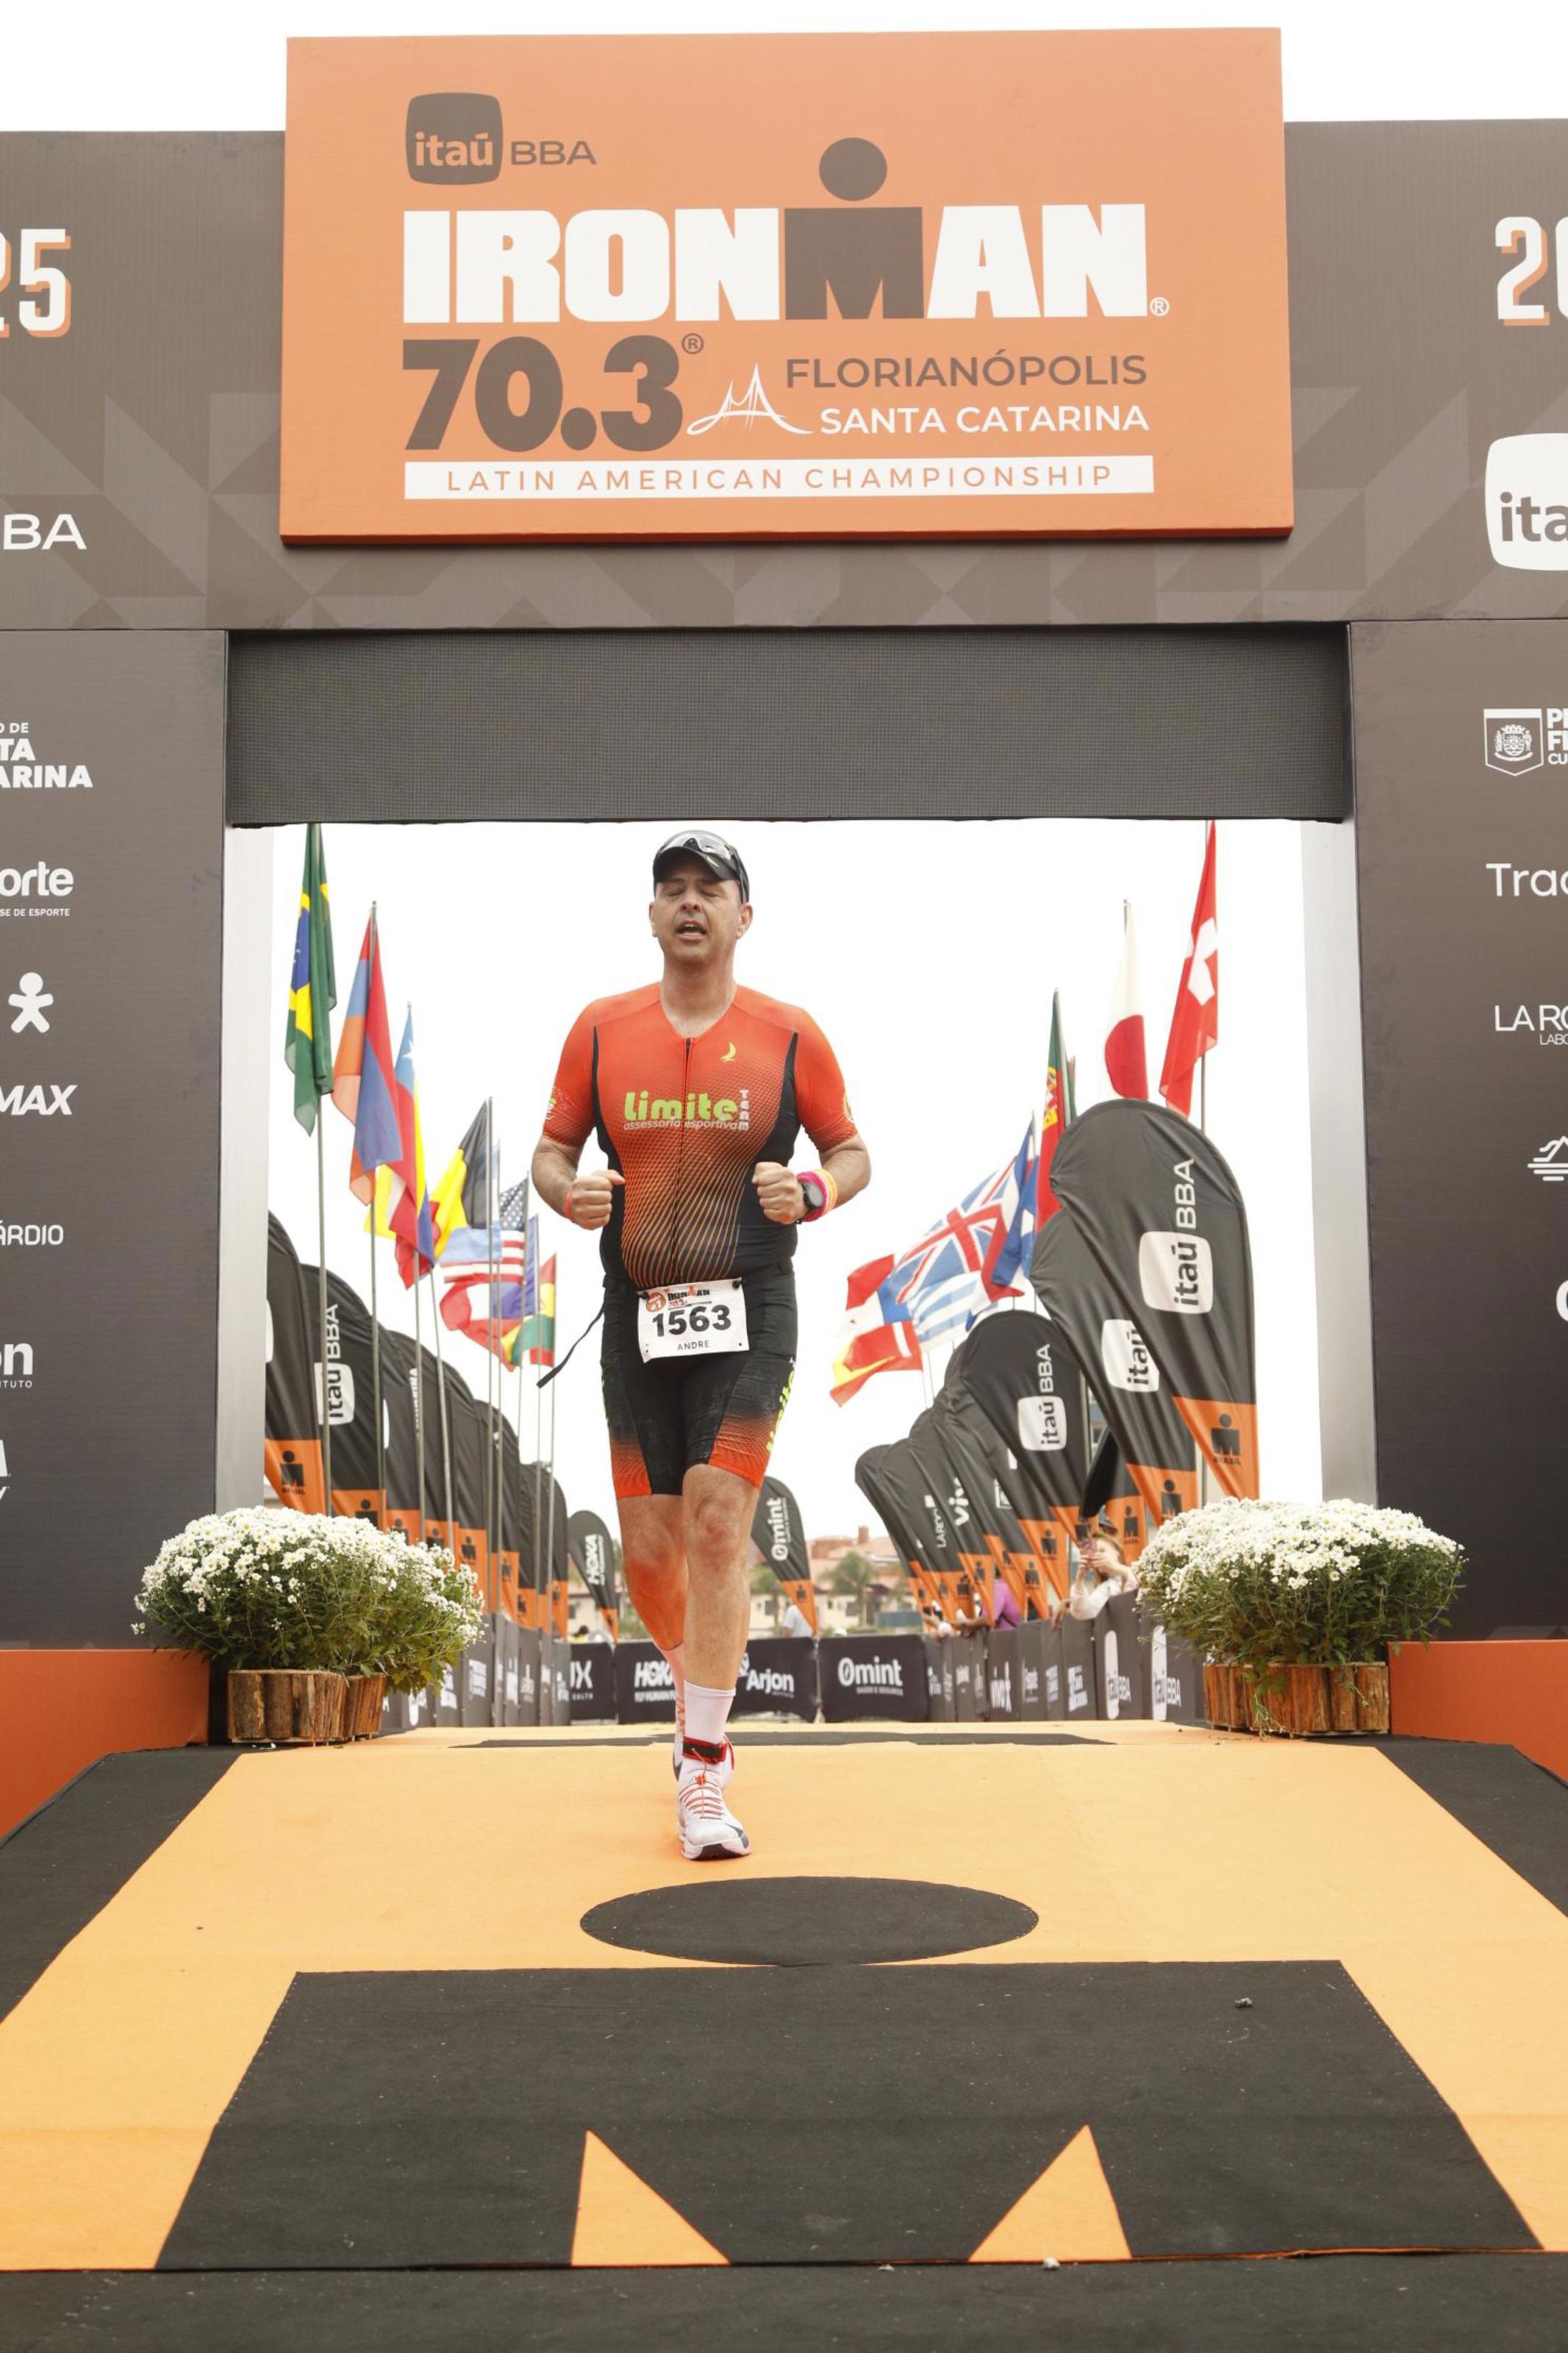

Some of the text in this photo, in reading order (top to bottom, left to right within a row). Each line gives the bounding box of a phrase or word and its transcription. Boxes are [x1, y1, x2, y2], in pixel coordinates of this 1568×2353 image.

[415, 131, 597, 166] itaú BBA
[0, 228, 71, 338] 5
[1495, 216, 1568, 326] 2
[786, 349, 1148, 389] FLORIANÓPOLIS
[820, 404, 1150, 434] SANTA CATARINA
[448, 465, 1111, 491] LATIN AMERICAN CHAMPIONSHIP
[10, 723, 29, 733] DE
[14, 908, 26, 916] DE
[29, 908, 71, 917] ESPORTE
[623, 1116, 681, 1131] assessoria
[1170, 1158, 1200, 1306] itaú BBA
[652, 1304, 731, 1338] 1563
[677, 1340, 710, 1352] ANDRE
[1036, 1343, 1060, 1445] itaú BBA
[745, 1668, 795, 1694] Arjon
